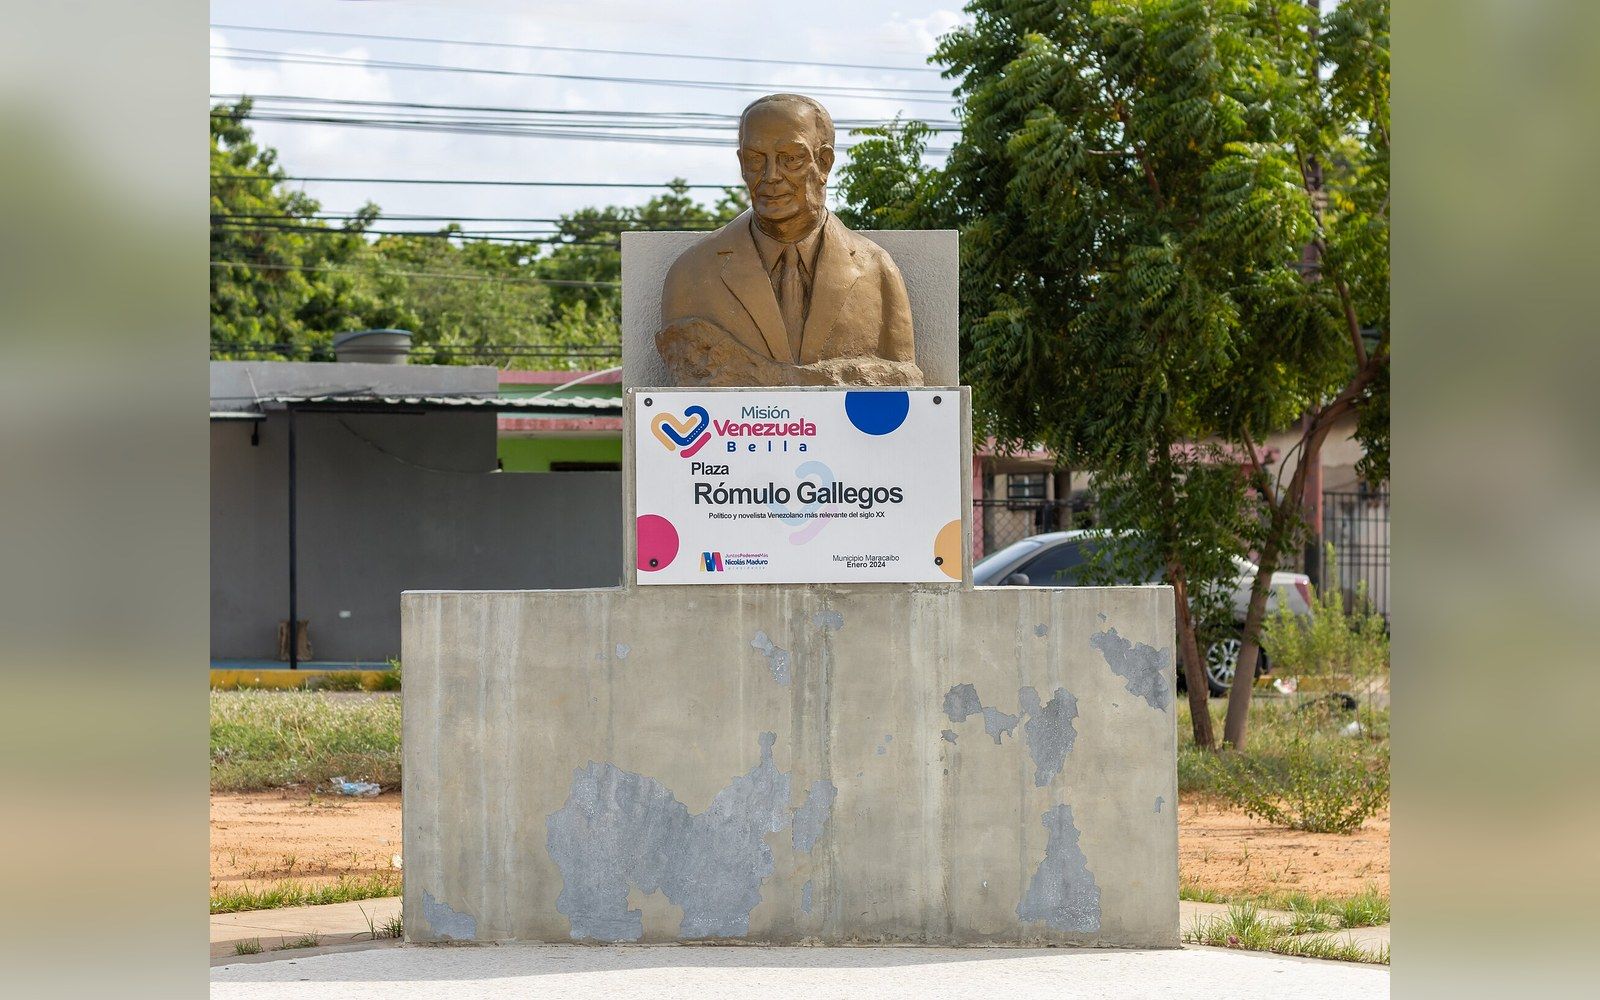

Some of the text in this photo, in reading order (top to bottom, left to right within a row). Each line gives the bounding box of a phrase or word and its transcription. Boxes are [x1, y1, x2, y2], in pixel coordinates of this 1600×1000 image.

[741, 406, 790, 419] Misión
[713, 418, 817, 437] Venezuela
[727, 441, 808, 452] Bella
[691, 462, 729, 475] Plaza
[694, 482, 904, 510] Rómulo Gallegos
[859, 512, 875, 520] siglo
